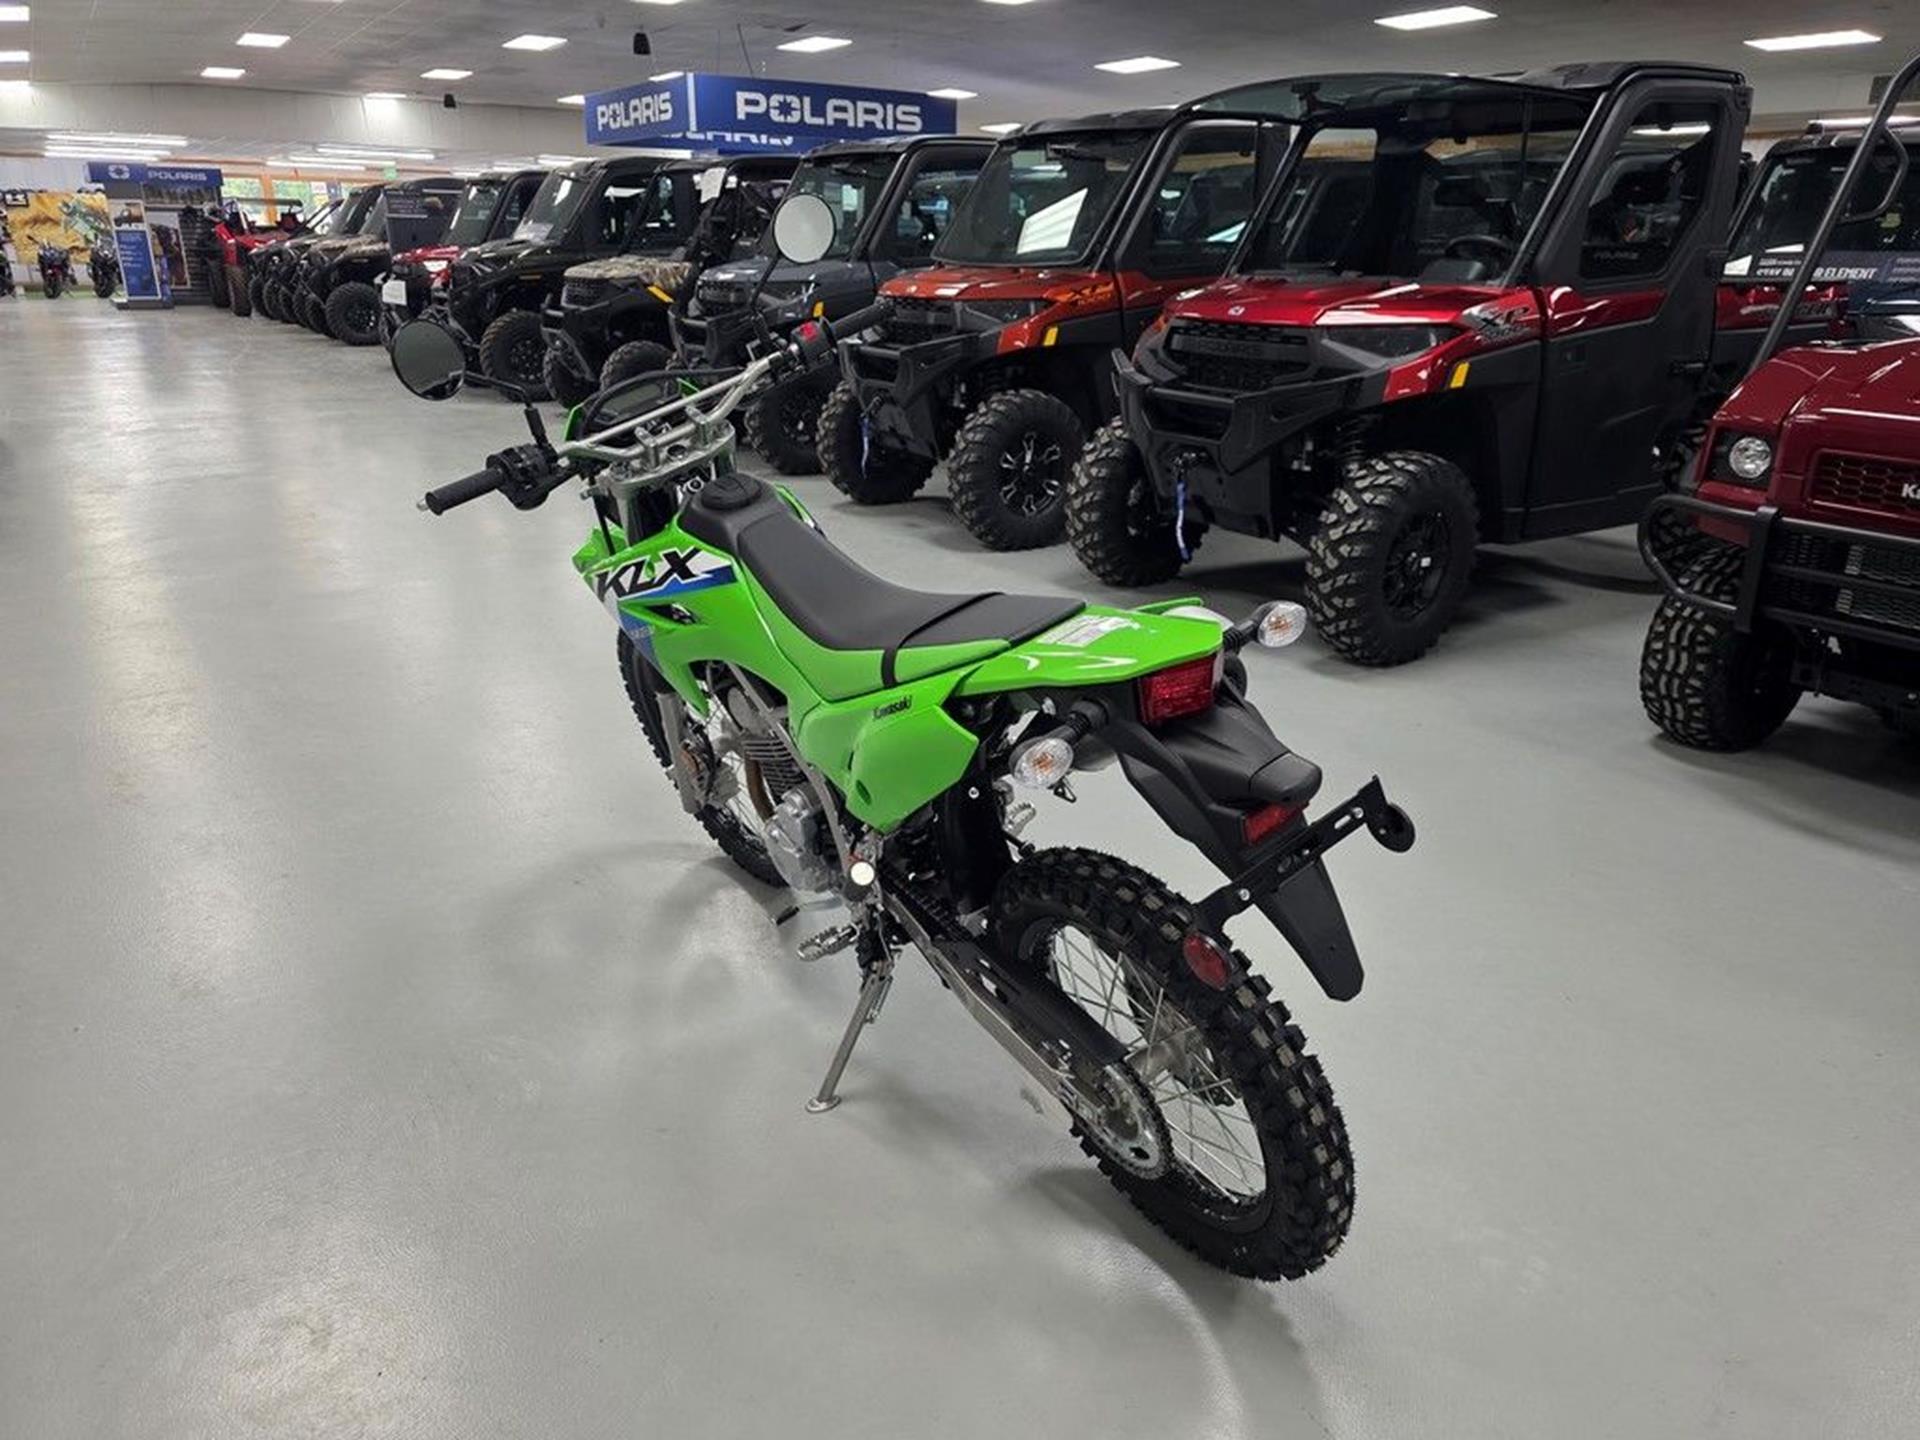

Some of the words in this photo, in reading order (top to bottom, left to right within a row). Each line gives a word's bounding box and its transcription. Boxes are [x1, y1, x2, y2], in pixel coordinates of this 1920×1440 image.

[596, 91, 673, 132] POLARIS
[735, 90, 923, 132] POLARIS
[148, 169, 207, 181] POLARIS
[596, 546, 703, 601] KLX
[873, 694, 913, 722] Kawasaki
